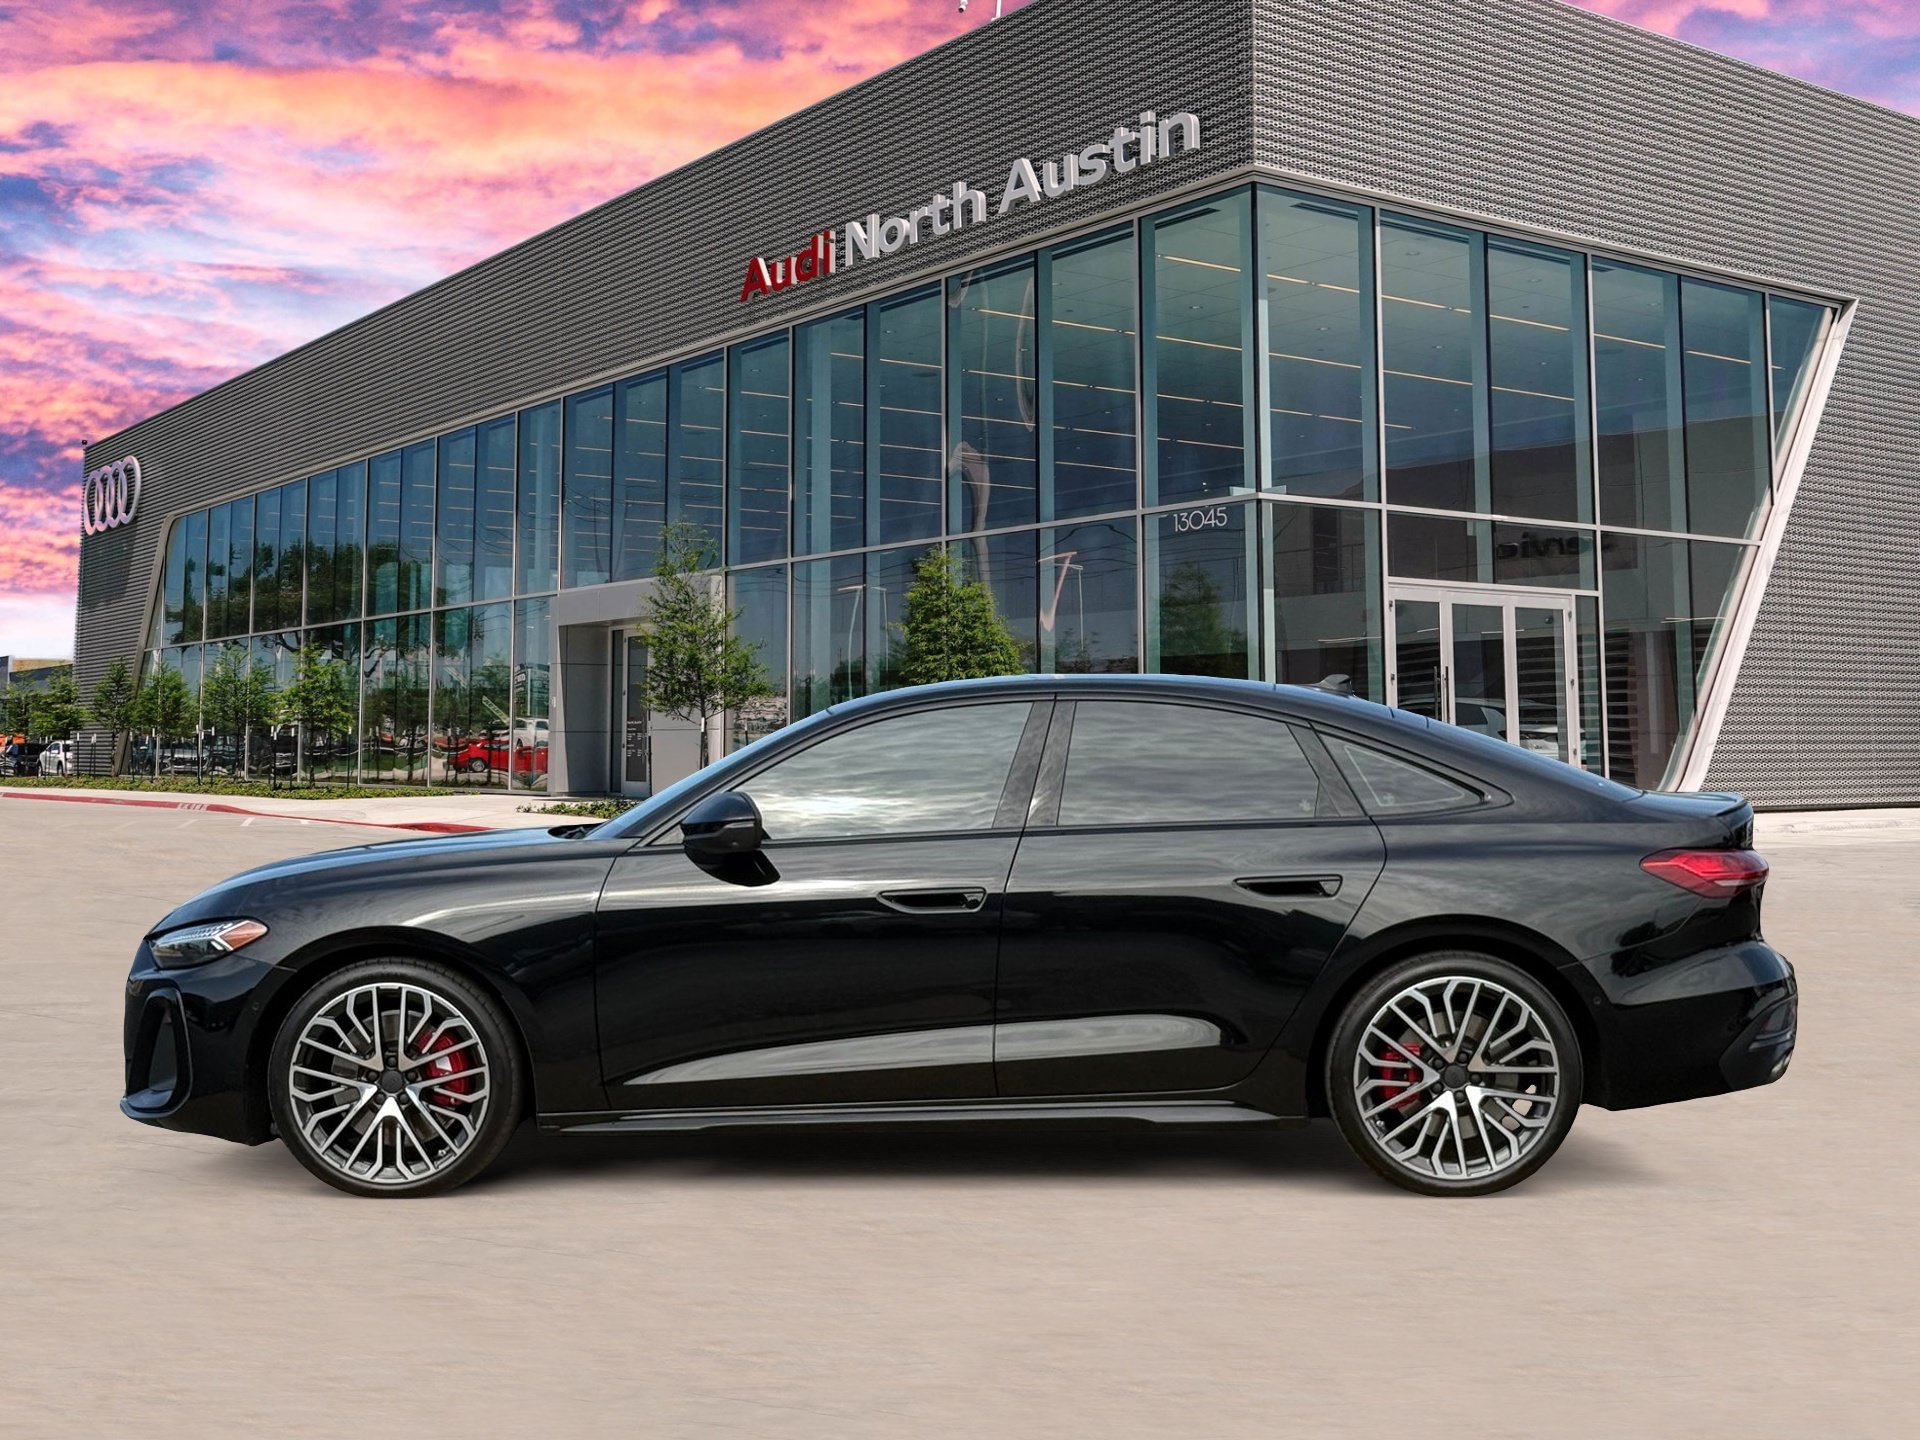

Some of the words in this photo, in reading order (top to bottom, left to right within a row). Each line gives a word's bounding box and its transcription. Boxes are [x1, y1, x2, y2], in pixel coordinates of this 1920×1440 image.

[740, 229, 836, 303] Audi
[845, 181, 987, 267] North
[998, 111, 1200, 213] Austin
[1173, 506, 1228, 532] 13045
